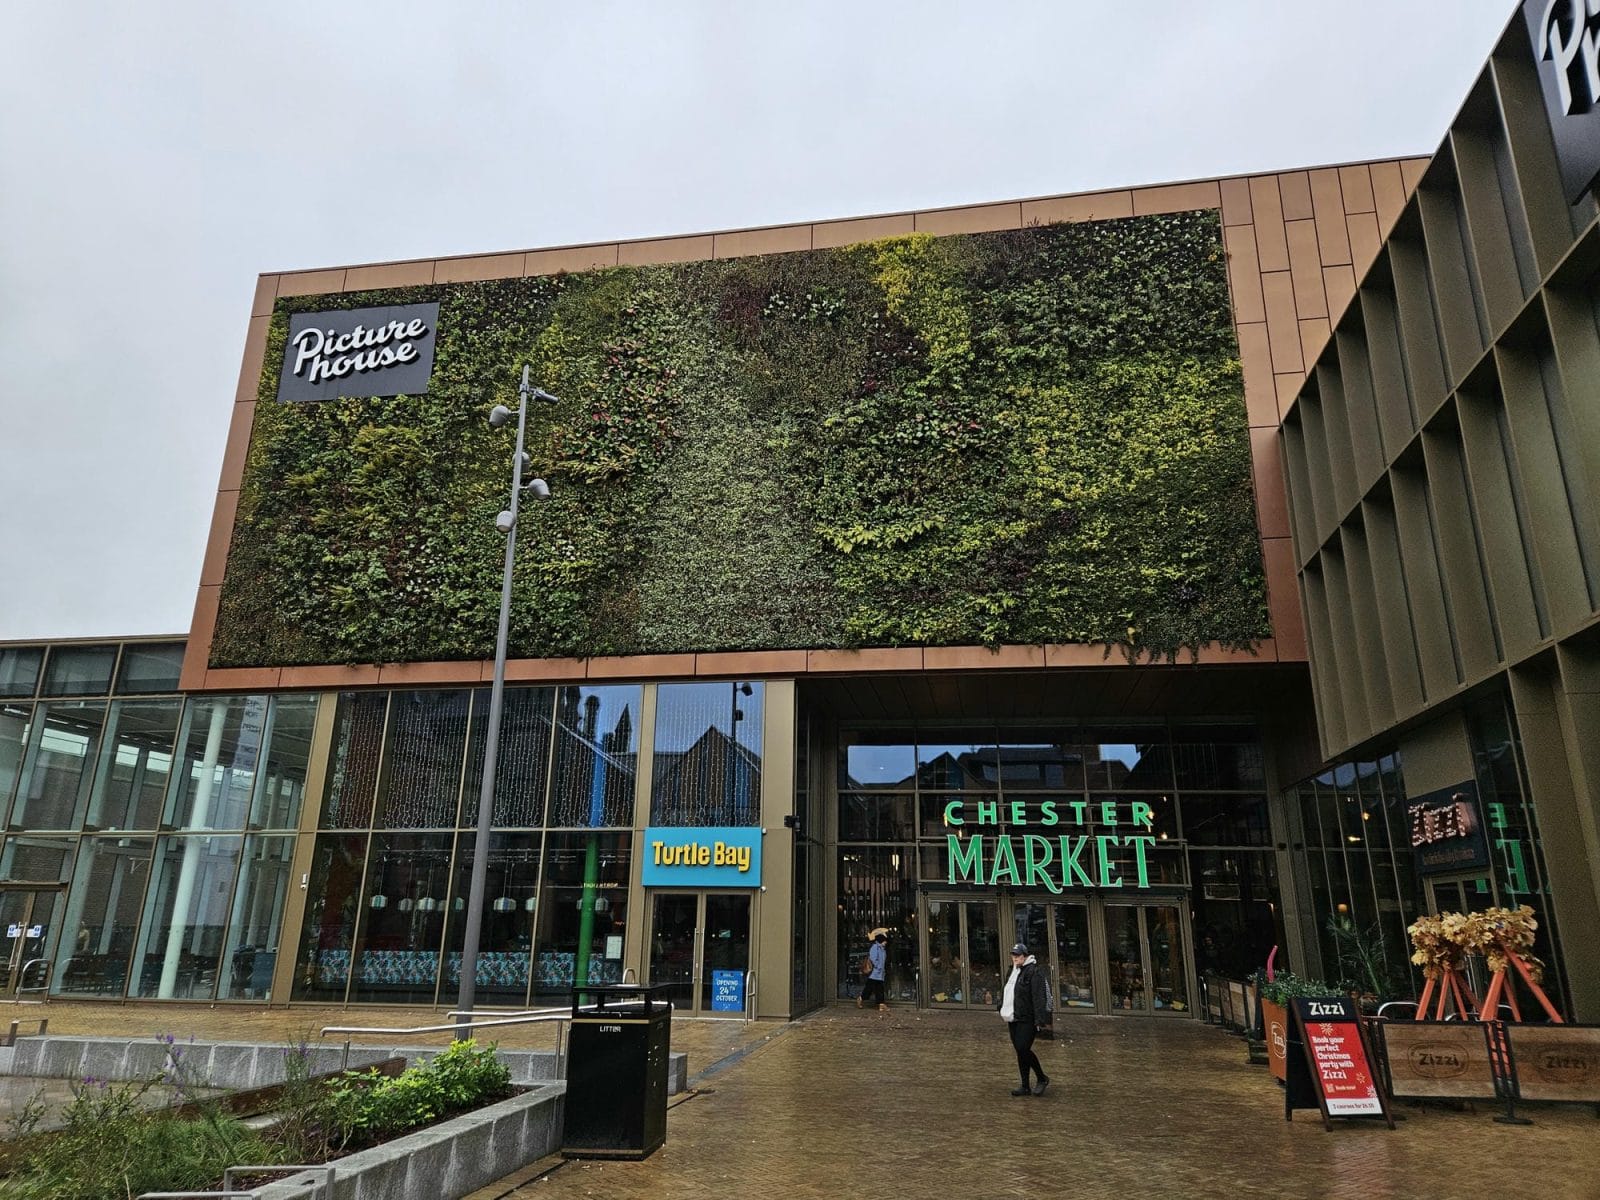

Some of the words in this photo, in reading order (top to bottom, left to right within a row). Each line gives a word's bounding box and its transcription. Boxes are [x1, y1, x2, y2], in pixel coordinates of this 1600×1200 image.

[292, 318, 426, 375] Picture
[308, 342, 418, 382] house
[944, 801, 1153, 826] CHESTER
[1408, 792, 1468, 847] Zizzi
[652, 841, 711, 866] Turtle
[714, 841, 751, 872] Bay
[946, 834, 1155, 894] MARKET
[715, 994, 738, 1002] OCTOBER
[1308, 1002, 1345, 1016] Zizzi
[599, 1025, 622, 1033] LITTER
[1329, 1037, 1345, 1045] your
[1314, 1044, 1340, 1053] perfect
[1319, 1061, 1339, 1070] party
[1339, 1060, 1355, 1068] with
[1419, 1053, 1460, 1067] Zizzi
[1546, 1055, 1587, 1069] Zizzi
[1322, 1069, 1347, 1079] Zizzi
